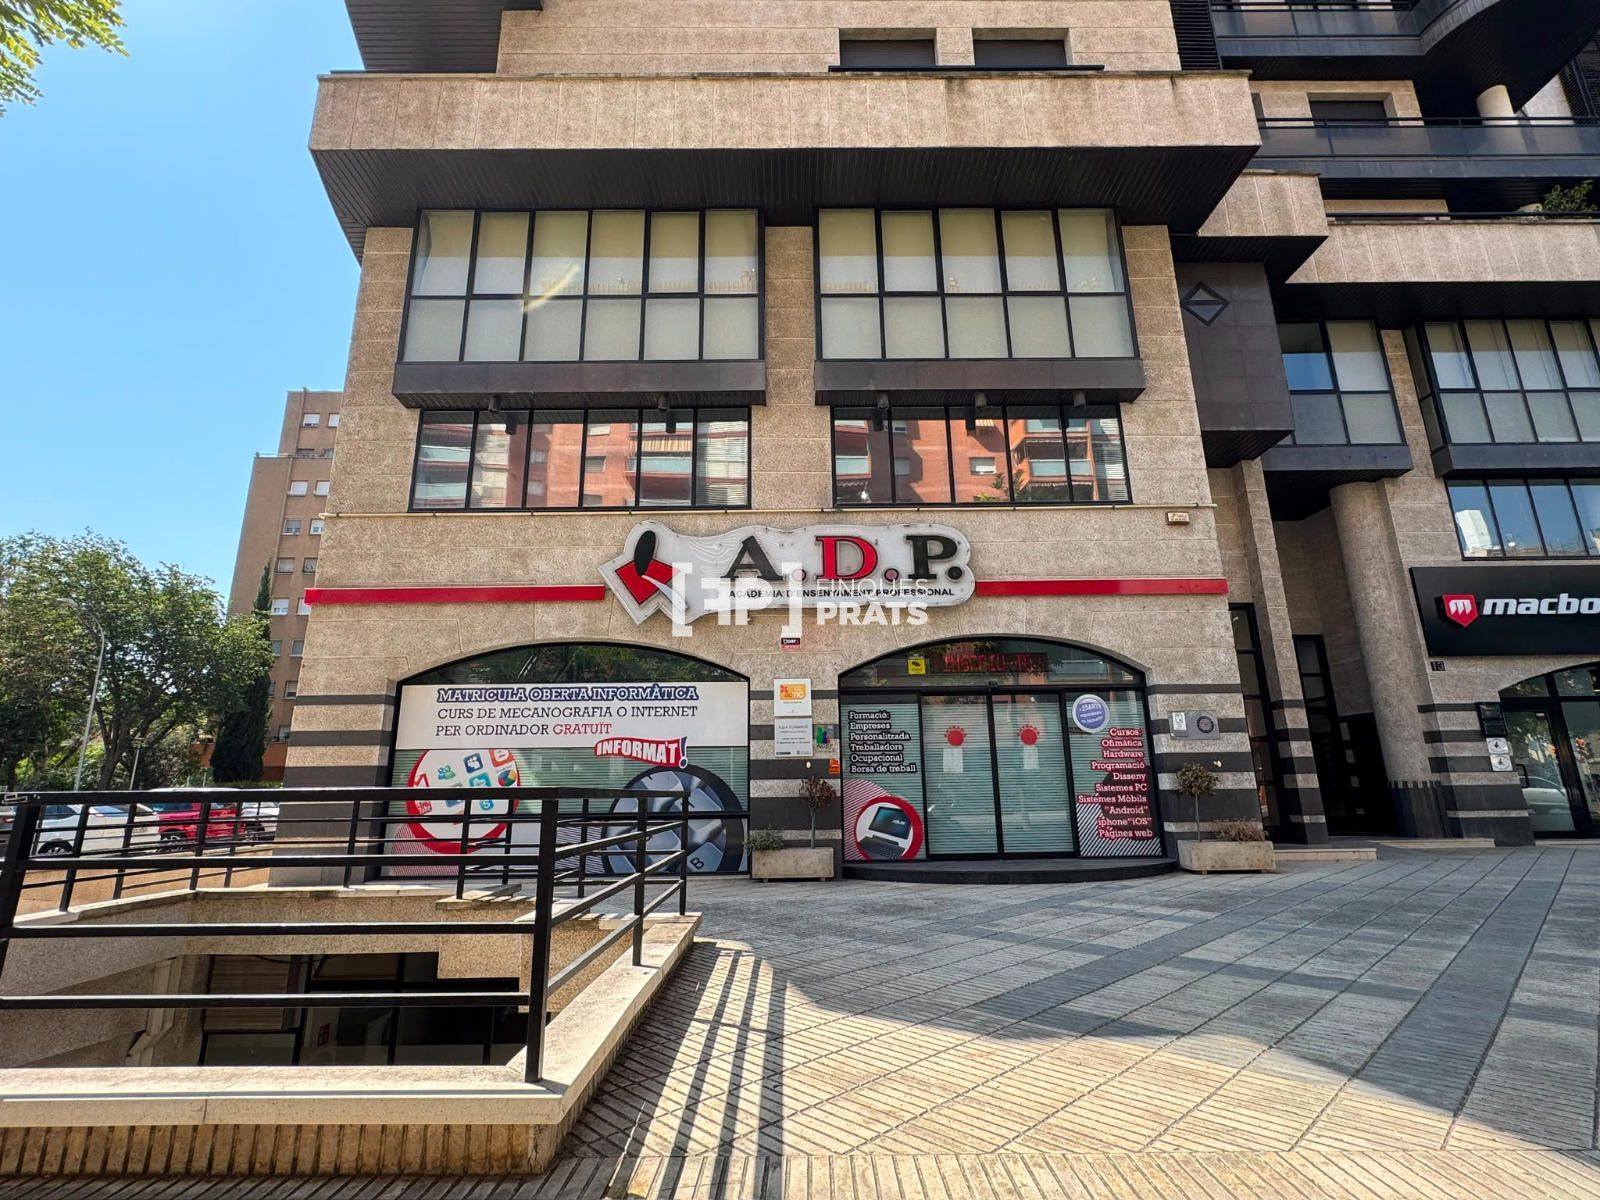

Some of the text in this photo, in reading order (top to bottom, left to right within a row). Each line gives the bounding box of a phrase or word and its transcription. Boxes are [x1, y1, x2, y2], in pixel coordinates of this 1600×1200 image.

[875, 588, 956, 599] PROFESSIONAL
[437, 683, 699, 702] MATRICULA OBERTA INFORMÀTICA
[437, 705, 698, 720] CURS DE MECANOGRAFIA O INTERNET
[435, 724, 461, 737] PER
[464, 723, 549, 736] ORDINADOR
[849, 722, 891, 731] Empreses
[850, 732, 910, 741] Personalitzada
[850, 743, 903, 751] Treballadors
[851, 753, 903, 763] Ocupacional
[1103, 750, 1144, 758] Hardware
[851, 764, 916, 773] Borsa de treball
[1091, 761, 1145, 771] Programació
[1113, 772, 1147, 781] Disseny
[1095, 783, 1148, 792] Sistemes PC
[1134, 828, 1153, 837] web
